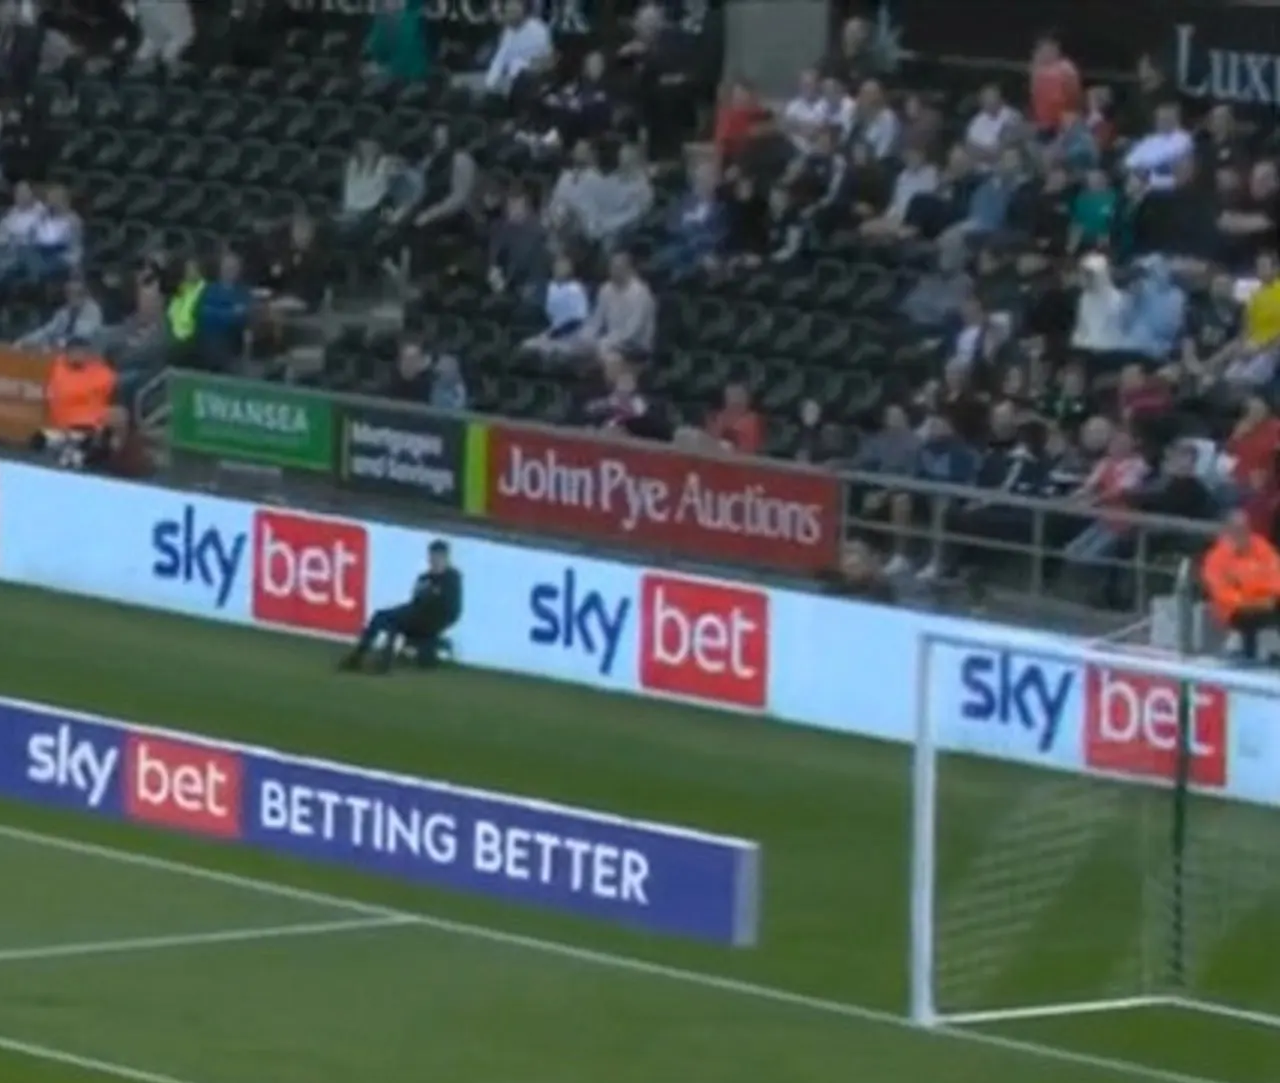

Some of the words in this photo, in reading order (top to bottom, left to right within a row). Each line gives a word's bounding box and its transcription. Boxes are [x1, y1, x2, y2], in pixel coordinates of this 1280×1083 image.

[193, 391, 310, 433] SWANSEA
[497, 446, 592, 510] John
[600, 459, 669, 532] Pye
[676, 471, 823, 545] Auctions
[152, 504, 246, 609] sky
[262, 519, 357, 610] bet
[529, 566, 631, 675] sky
[653, 585, 757, 679] bet
[961, 651, 1075, 752] sky
[1100, 669, 1215, 755] bet
[27, 725, 119, 806] sky
[136, 744, 228, 817] bet
[259, 779, 458, 864] BETTING
[473, 821, 650, 904] BETTER
